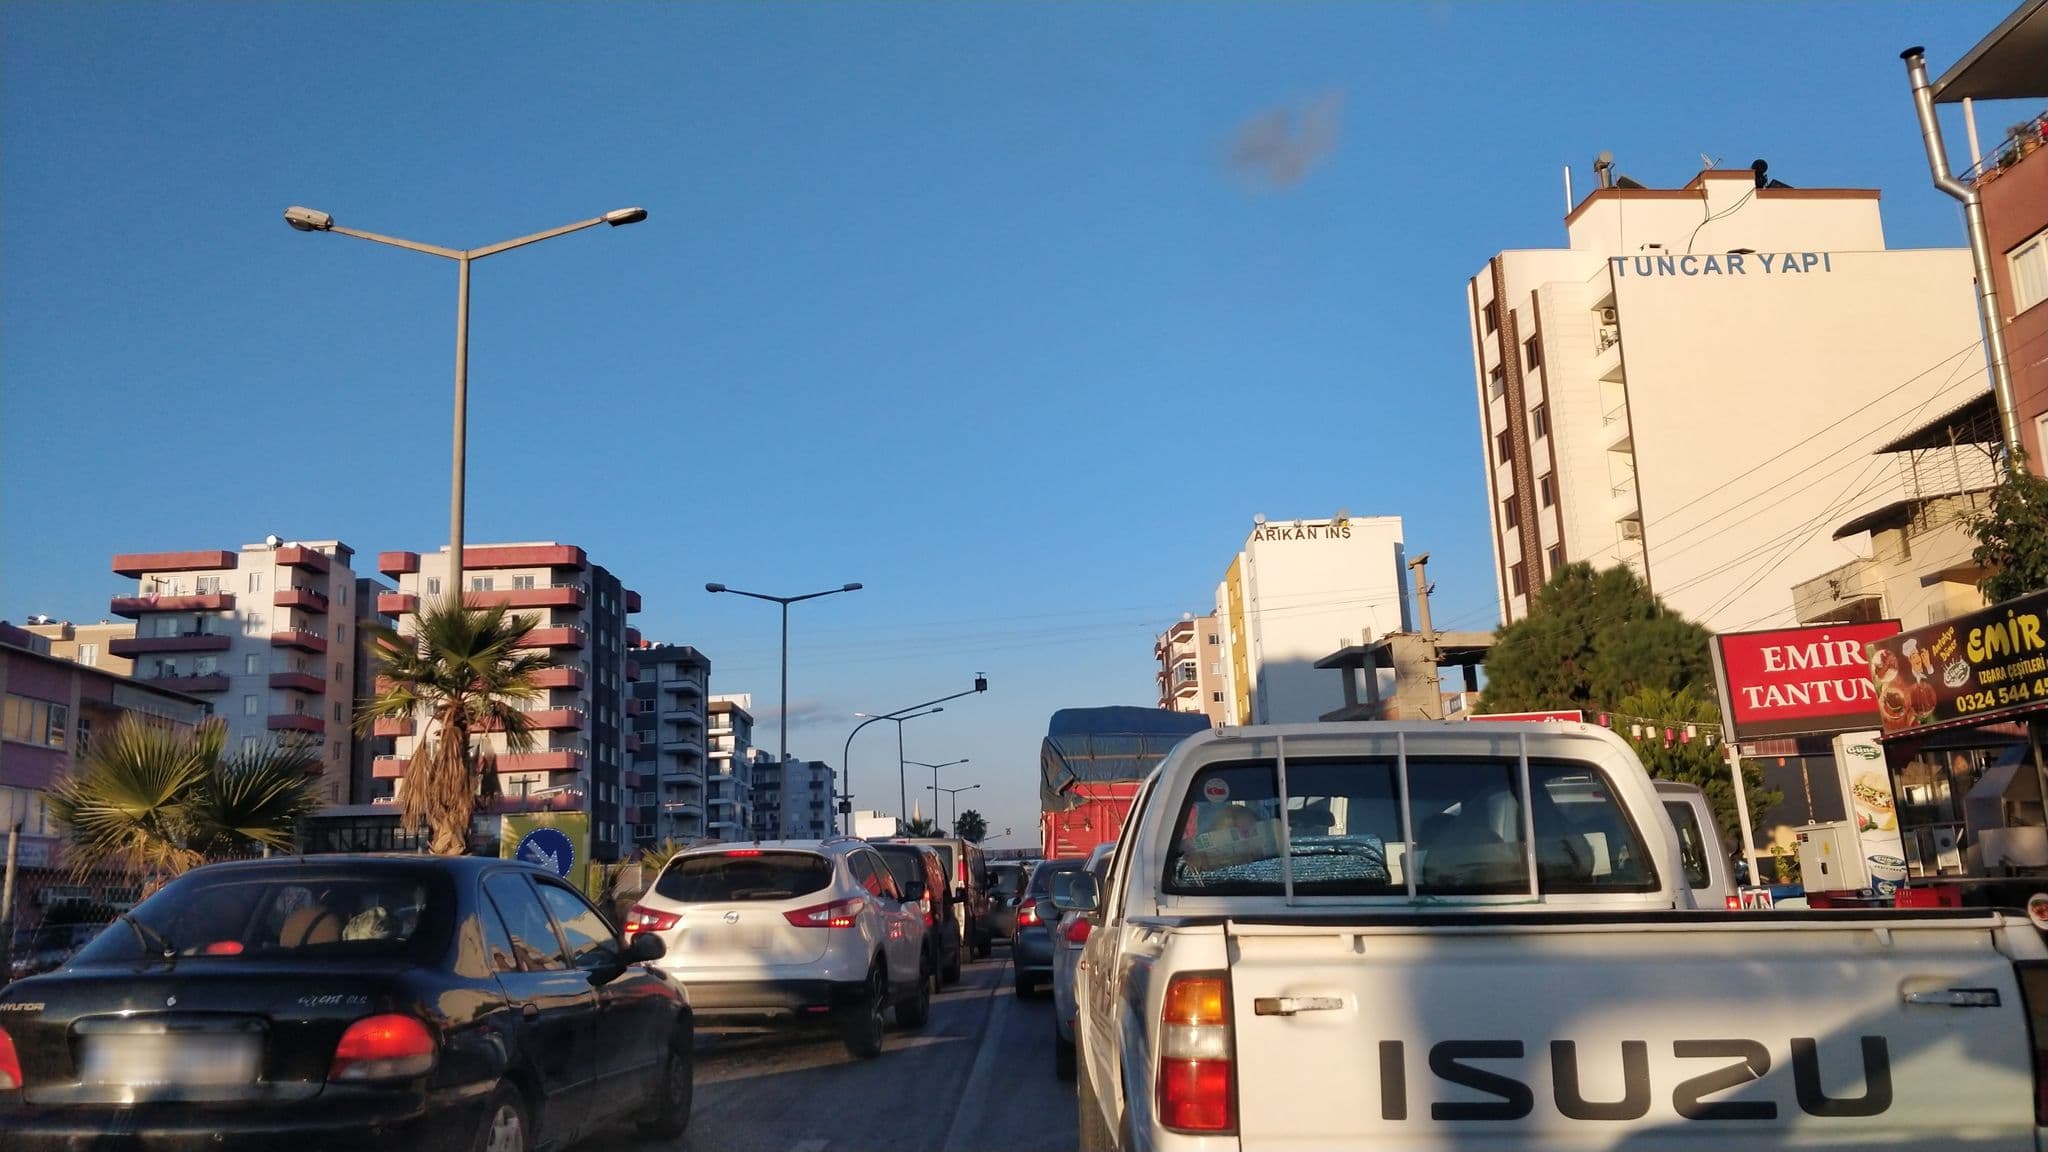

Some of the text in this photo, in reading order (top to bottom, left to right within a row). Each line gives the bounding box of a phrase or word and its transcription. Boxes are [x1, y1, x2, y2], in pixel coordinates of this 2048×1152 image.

[1611, 252, 1832, 277] TUNCAR YAPI
[1254, 527, 1318, 542] ARIKAN
[1967, 609, 2046, 663] EMİR
[1760, 634, 1869, 672] EMİR
[1978, 652, 2046, 685] IZGARA ÇEŞİTLERİ
[1956, 689, 1996, 712] 0324
[1998, 682, 2030, 704] 544
[1379, 1035, 1894, 1121] ISUZU
